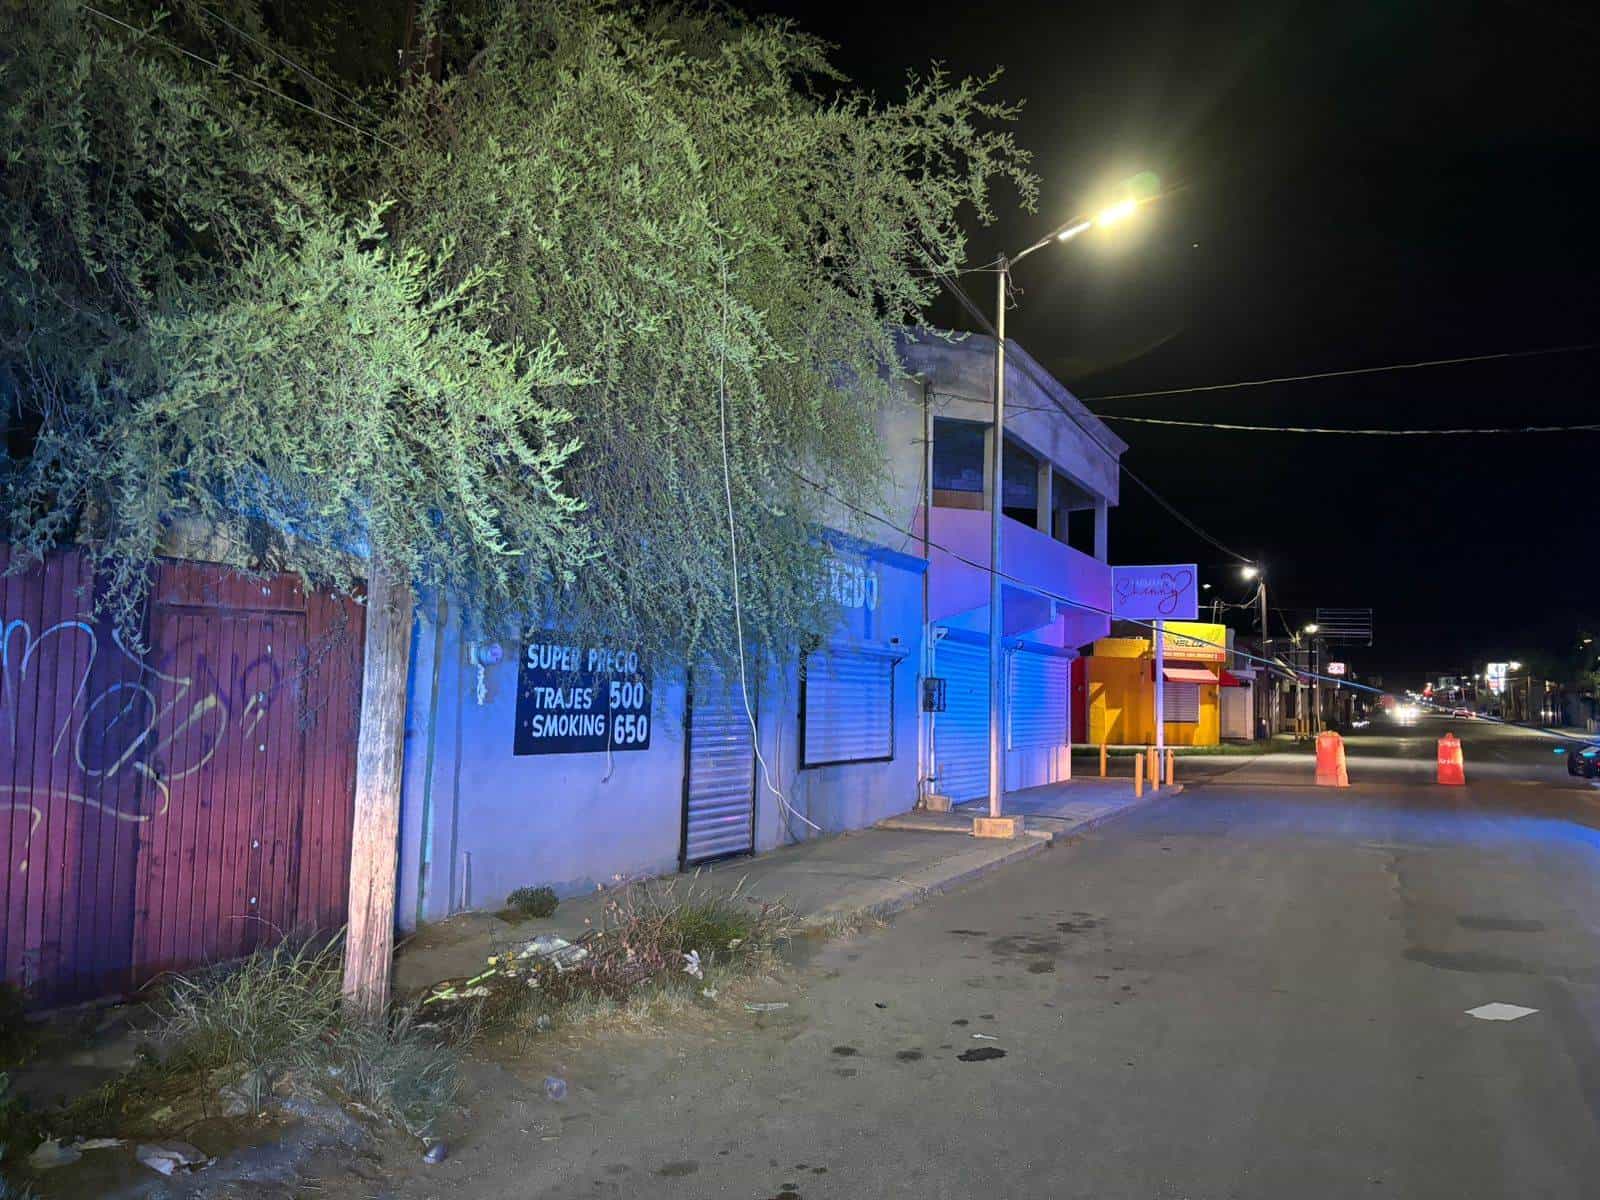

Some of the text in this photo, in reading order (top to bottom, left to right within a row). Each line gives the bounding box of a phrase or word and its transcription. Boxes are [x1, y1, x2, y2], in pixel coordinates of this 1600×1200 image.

[527, 644, 638, 673] SUPER PRECIO
[534, 681, 644, 710] TRAJES 500
[532, 714, 648, 745] SMOKING 650
